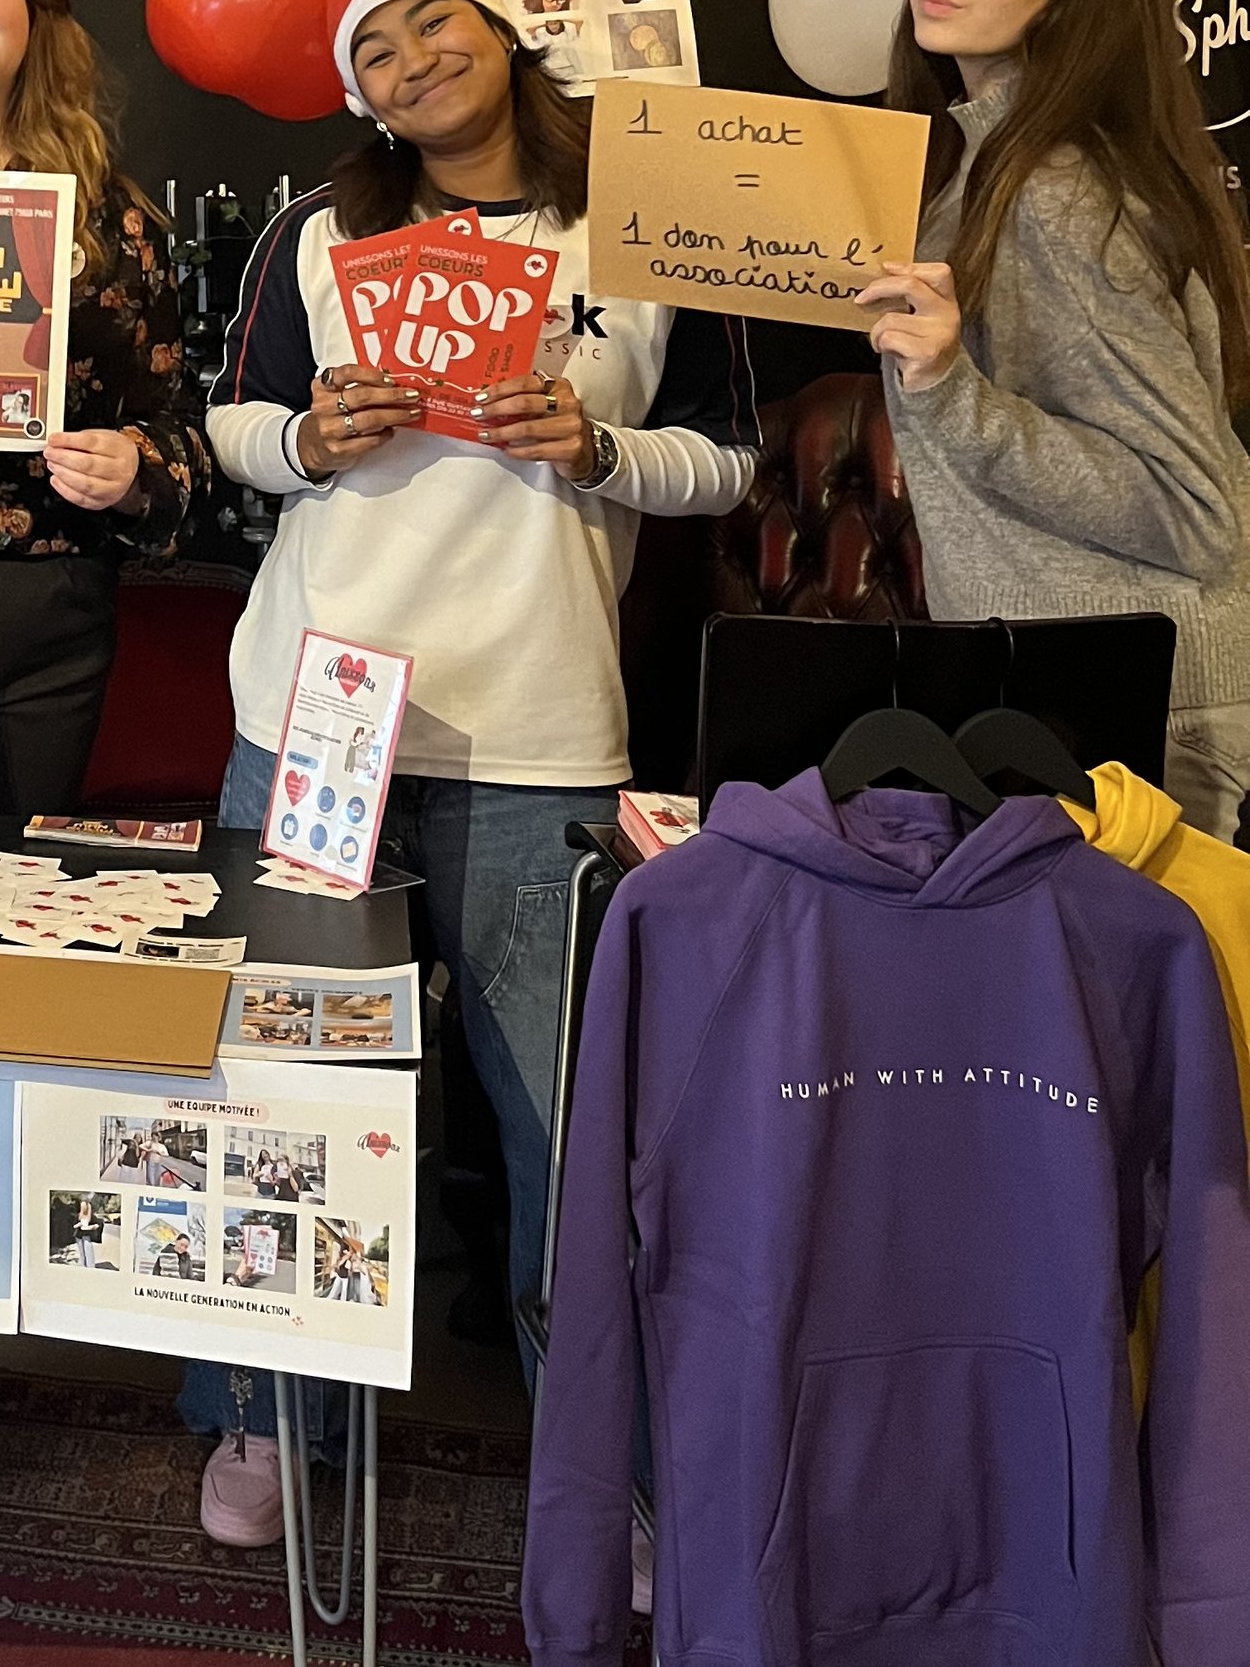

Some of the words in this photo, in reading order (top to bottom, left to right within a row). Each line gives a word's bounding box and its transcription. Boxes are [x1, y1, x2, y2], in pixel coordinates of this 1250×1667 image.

[627, 99, 662, 135] 1
[698, 115, 803, 146] achat
[622, 211, 652, 245] 1
[664, 222, 725, 251] don
[738, 234, 828, 260] pour
[342, 248, 394, 269] UNISSONS
[345, 254, 408, 282] COEUR
[417, 254, 484, 277] COEURS
[420, 244, 470, 262] UNISSONS
[470, 253, 489, 265] LES
[404, 271, 534, 332] POP
[394, 320, 476, 374] UP
[544, 340, 601, 360] SSIC
[780, 1071, 855, 1099] HUMAN
[877, 1069, 944, 1085] WITH
[963, 1067, 1100, 1114] ATTITUDE
[168, 1099, 185, 1110] UNE
[186, 1101, 218, 1113] EQUIPE
[219, 1104, 255, 1117] MOTIVÉE
[134, 1286, 145, 1297] LA
[146, 1288, 189, 1303] NOUVELLE
[191, 1294, 244, 1310] GENERATION
[246, 1301, 258, 1312] EN
[259, 1303, 291, 1317] ACTION
